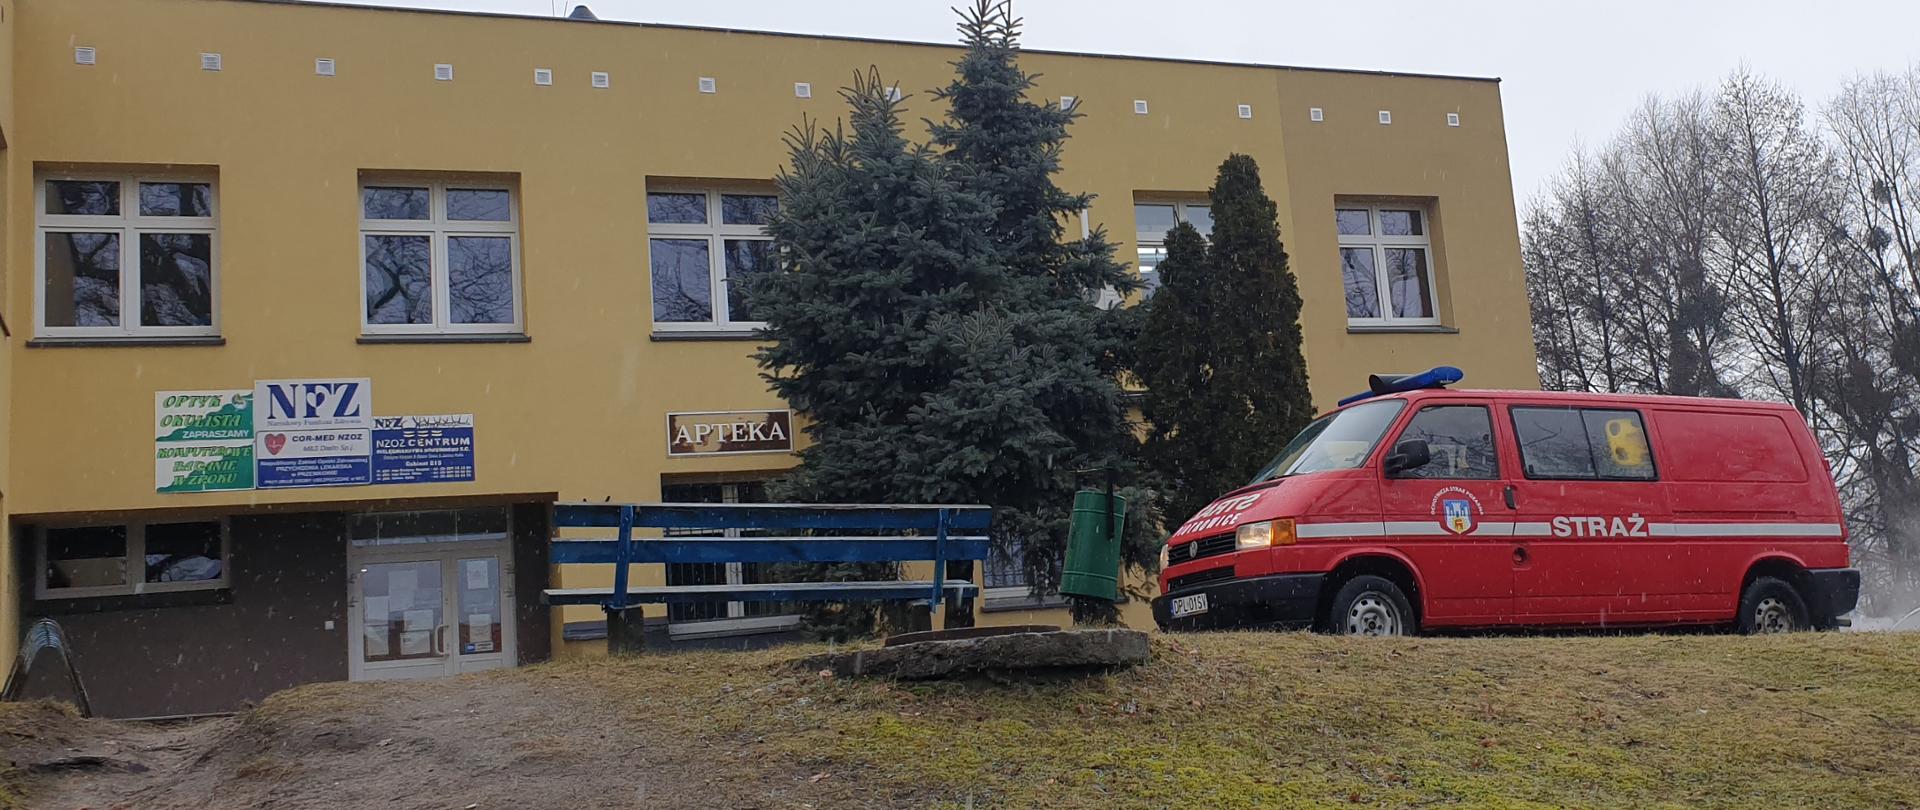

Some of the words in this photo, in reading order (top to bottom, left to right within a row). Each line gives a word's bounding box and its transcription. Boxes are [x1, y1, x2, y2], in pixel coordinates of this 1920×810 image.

[162, 394, 223, 408] OPTYK
[266, 382, 361, 419] NFZ
[160, 414, 242, 428] OKULISTA
[182, 429, 249, 439] ZAPRASZAMY
[292, 434, 335, 442] COR-MED
[337, 433, 363, 441] NZOZ
[671, 421, 787, 446] APTEKA
[376, 439, 406, 448] NZOZ
[408, 437, 471, 447] CENTRUM
[157, 445, 252, 459] KOMPUTEROWE
[173, 460, 237, 472] BADANIE
[1552, 512, 1648, 537] STRAŻ
